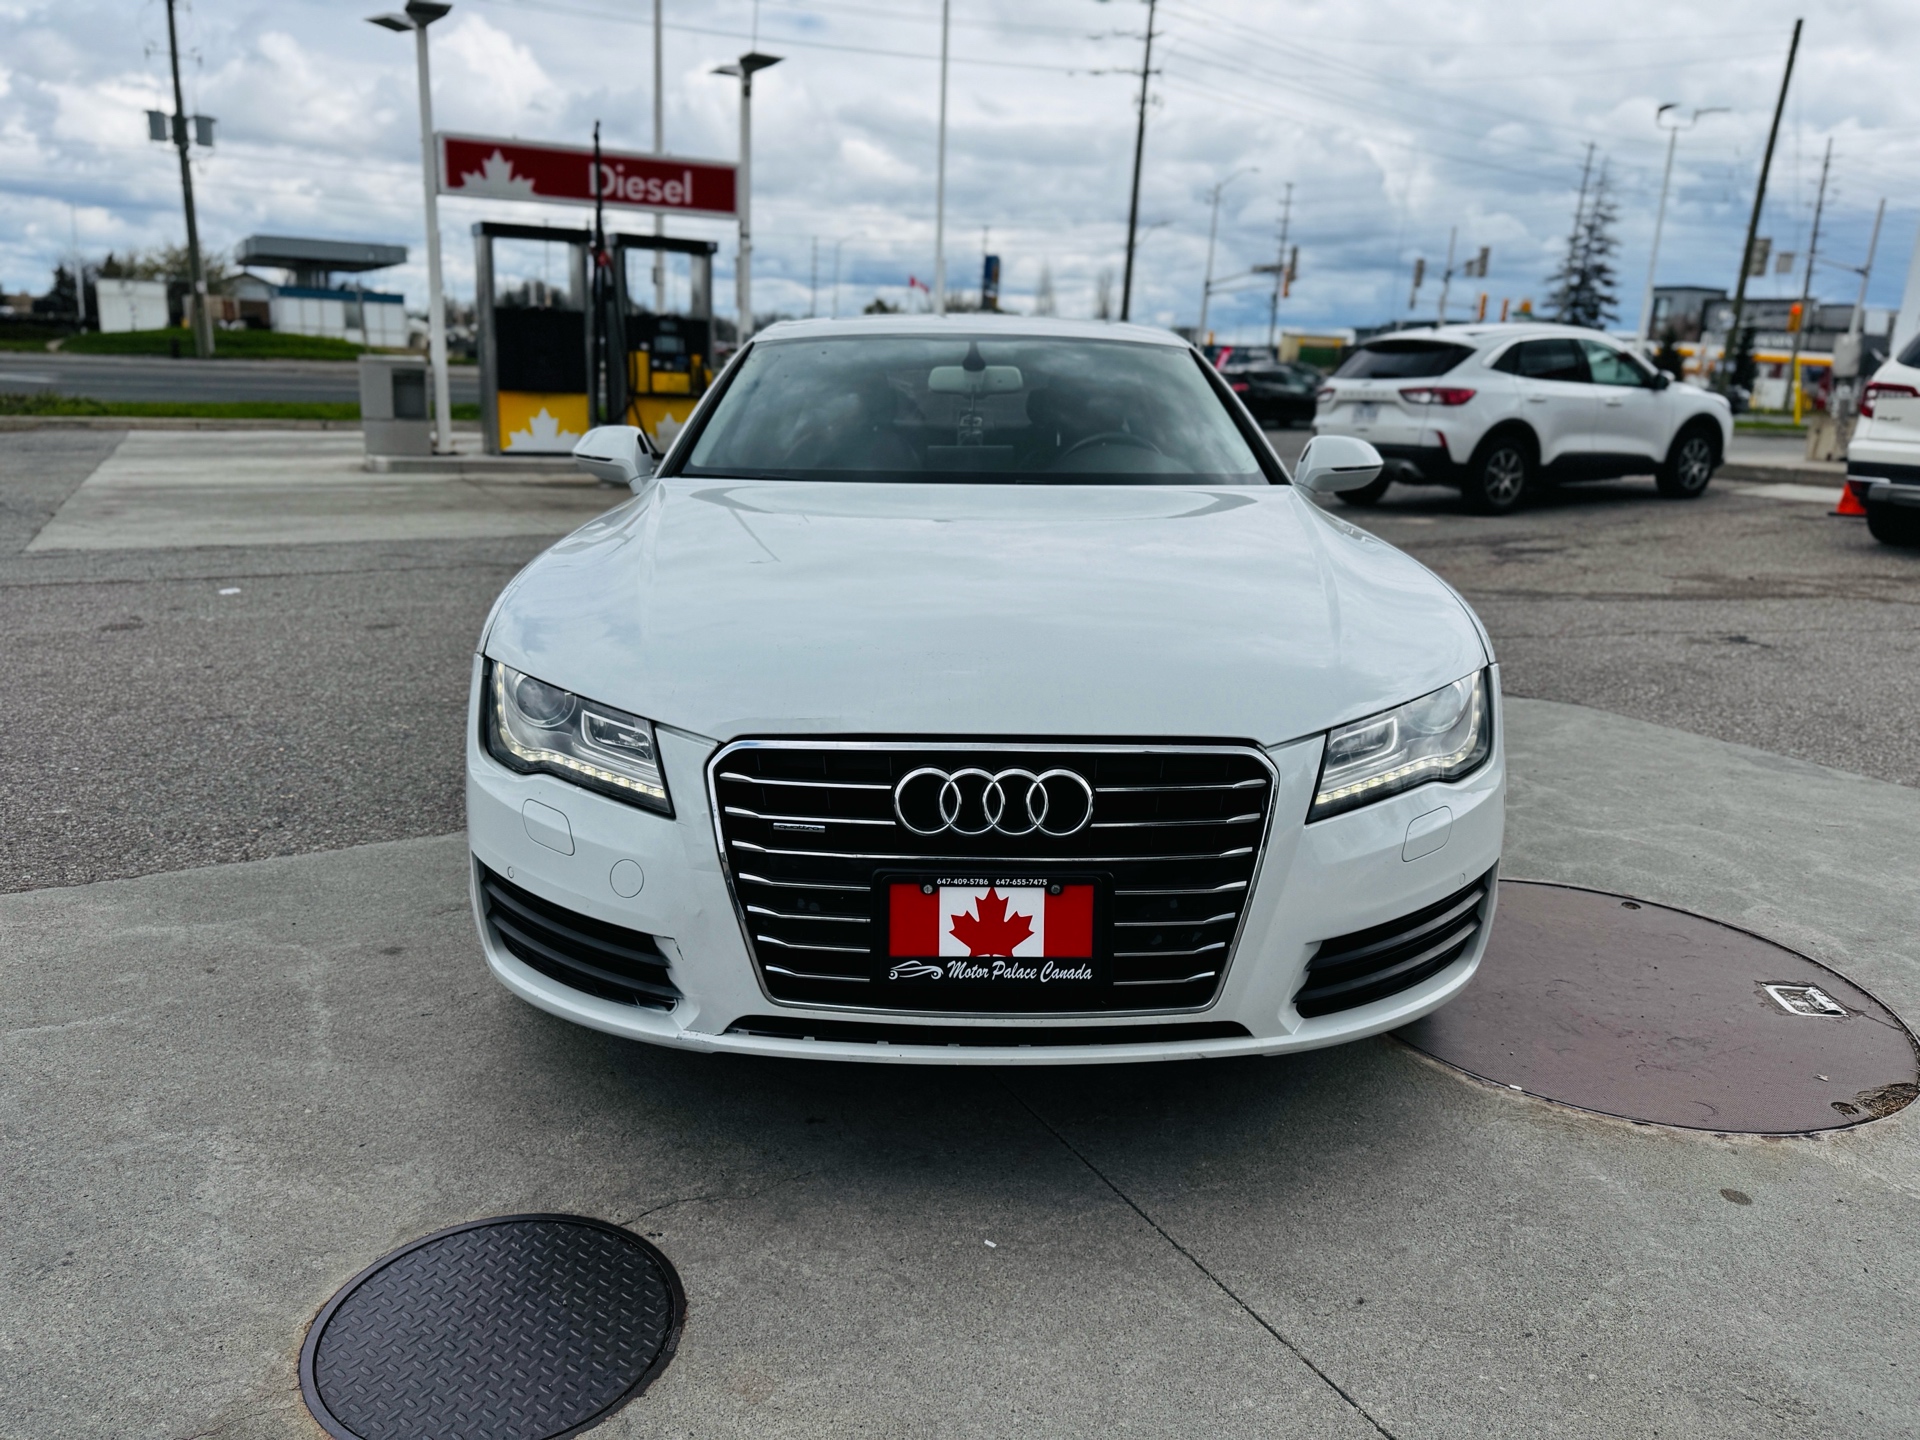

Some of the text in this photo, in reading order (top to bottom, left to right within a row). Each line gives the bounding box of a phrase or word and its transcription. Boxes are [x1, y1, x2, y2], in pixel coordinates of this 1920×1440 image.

[589, 162, 692, 204] Diesel
[995, 878, 1048, 886] 647-655-7475
[946, 960, 1093, 983] Motor Palace Canada
